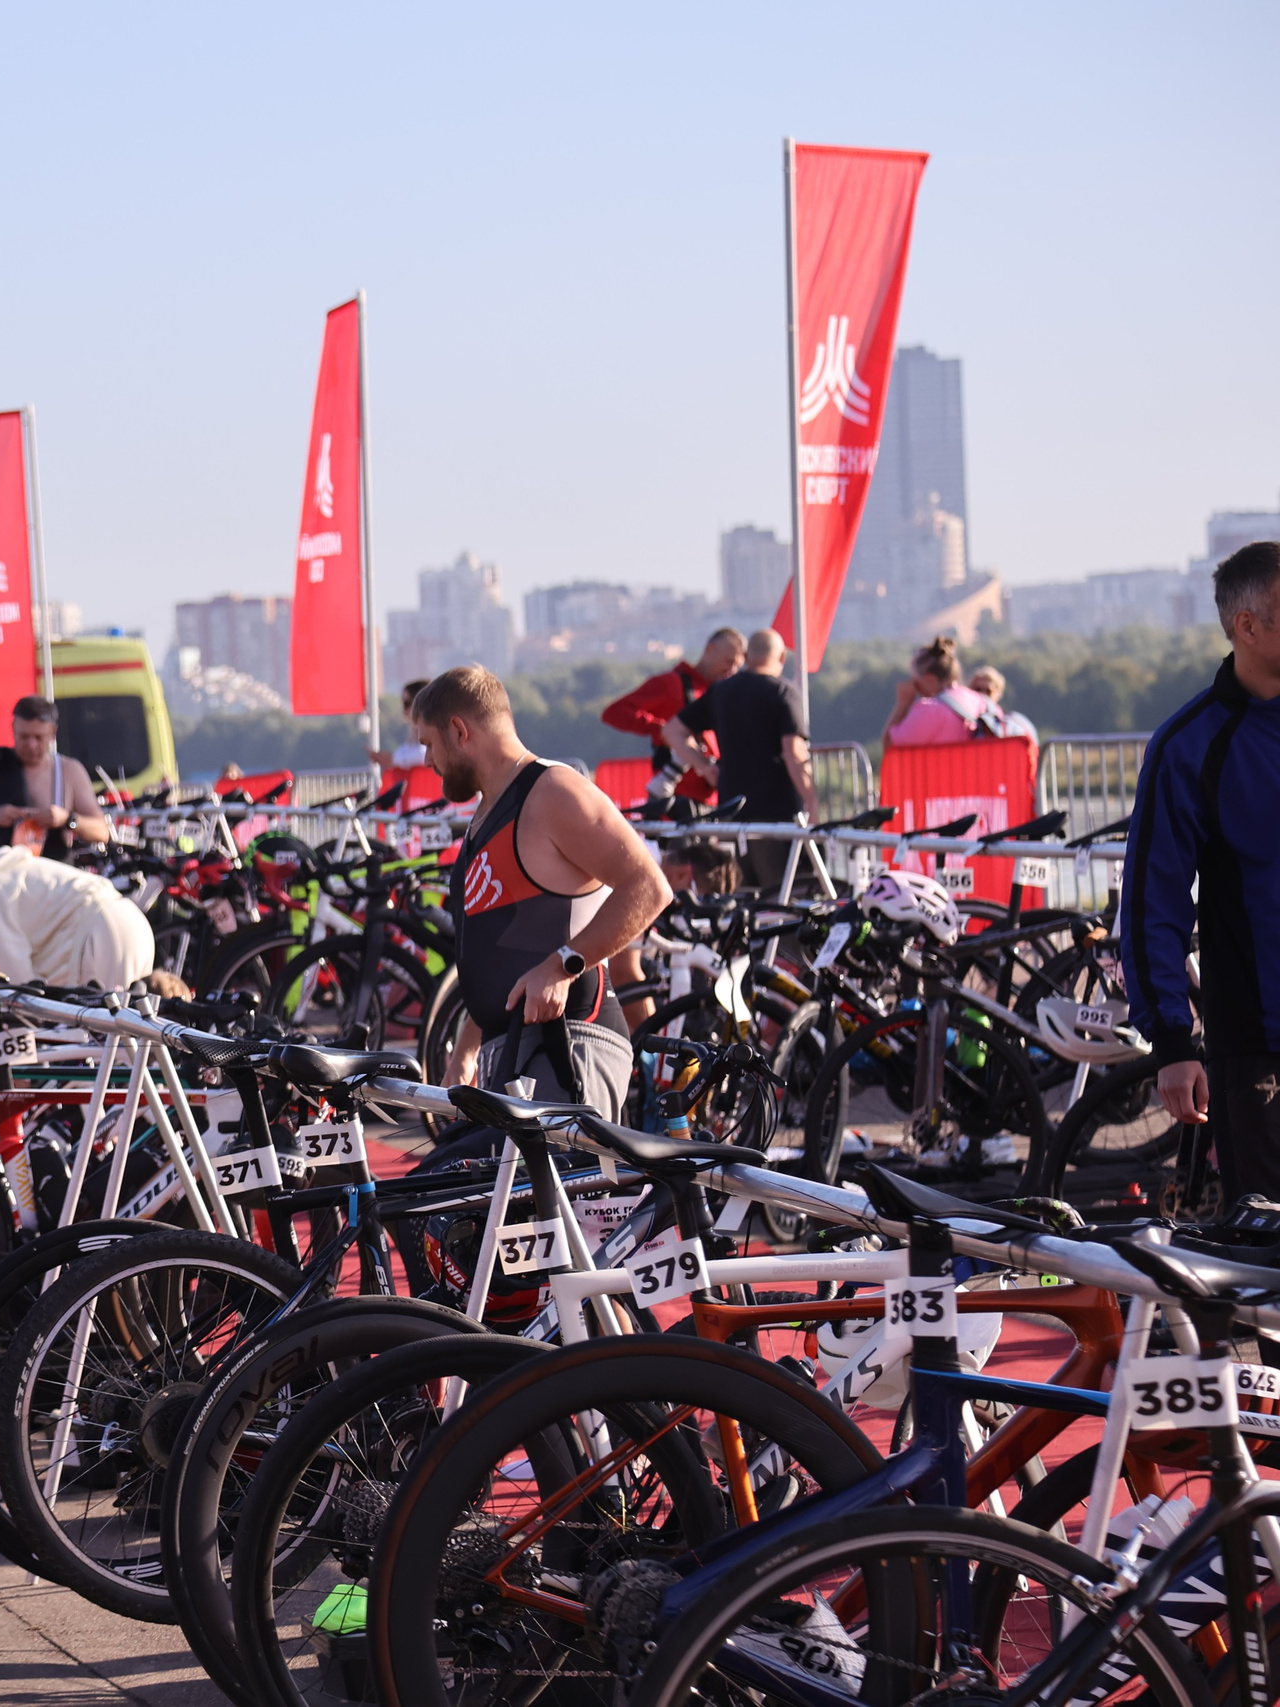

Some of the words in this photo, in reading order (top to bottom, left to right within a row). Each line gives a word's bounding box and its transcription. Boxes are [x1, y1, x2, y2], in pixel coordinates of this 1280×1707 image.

[305, 1132, 353, 1158] 373
[217, 1158, 263, 1186] 371
[584, 1207, 620, 1216] КУБОК
[501, 1231, 555, 1264] 377
[634, 1251, 700, 1295] 379
[890, 1289, 944, 1325] 383
[14, 1333, 44, 1420] STELS
[193, 1395, 215, 1433] GRAND
[213, 1373, 231, 1399] PRIX
[230, 1350, 255, 1375] 5000
[1237, 1369, 1277, 1393] 379
[1133, 1376, 1224, 1416] 385
